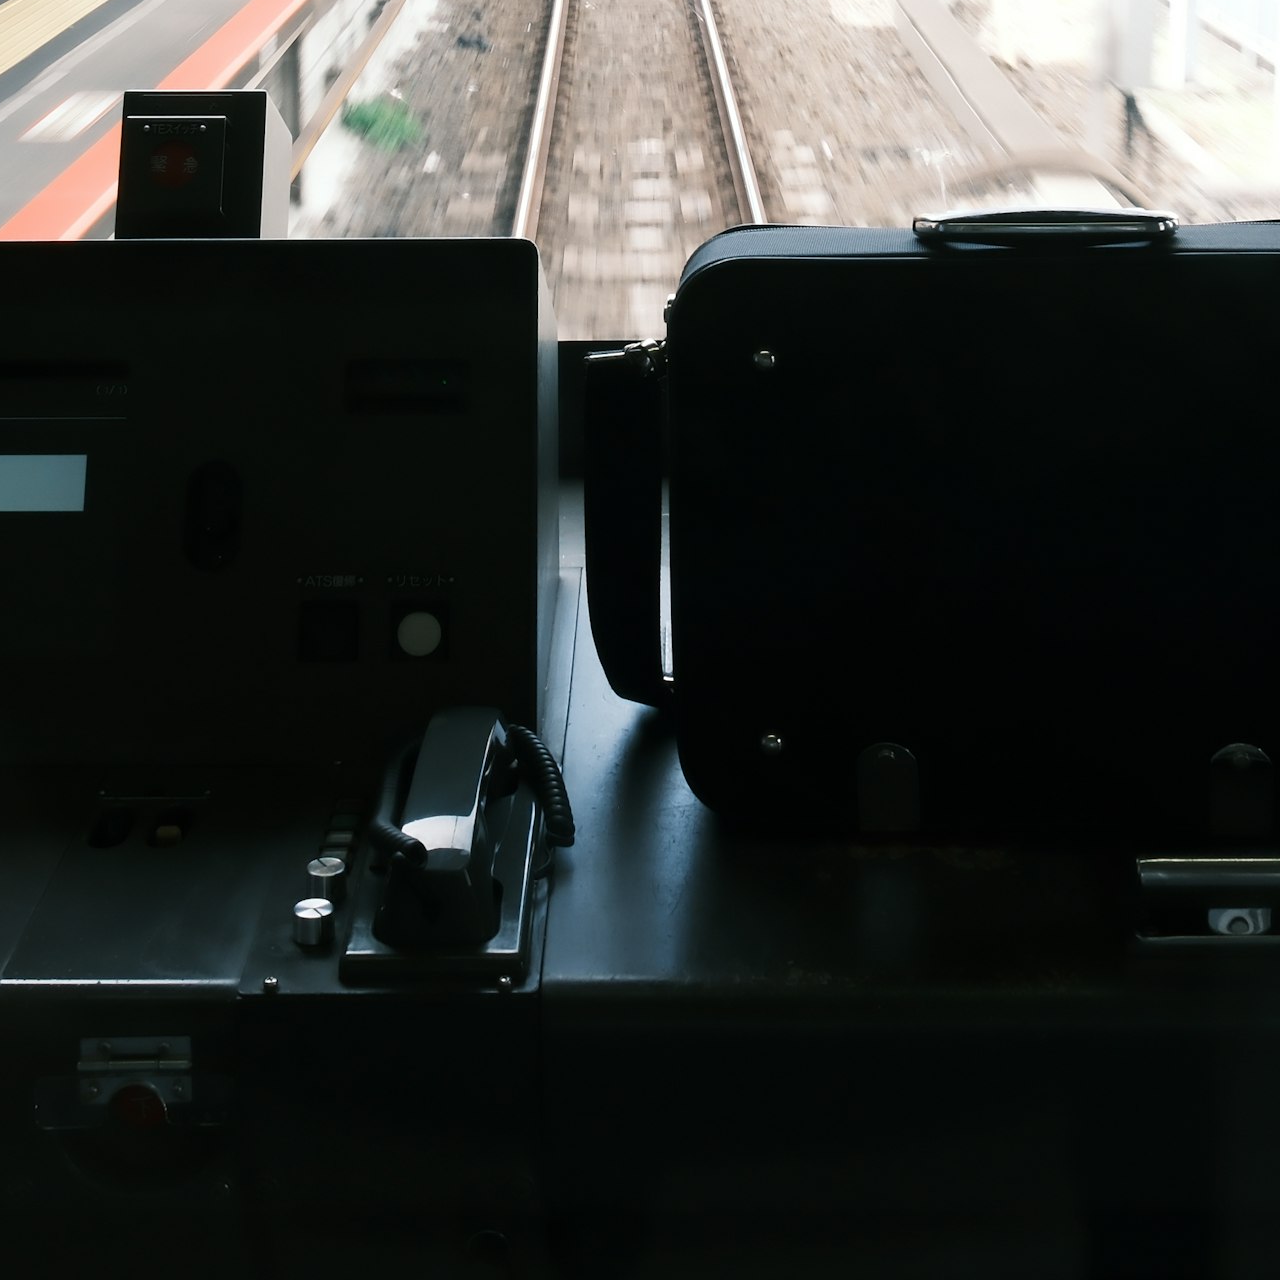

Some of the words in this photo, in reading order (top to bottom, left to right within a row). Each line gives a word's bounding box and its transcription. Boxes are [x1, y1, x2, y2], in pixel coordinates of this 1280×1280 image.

[152, 123, 198, 134] TEスイッチ
[395, 575, 448, 587] リセット
